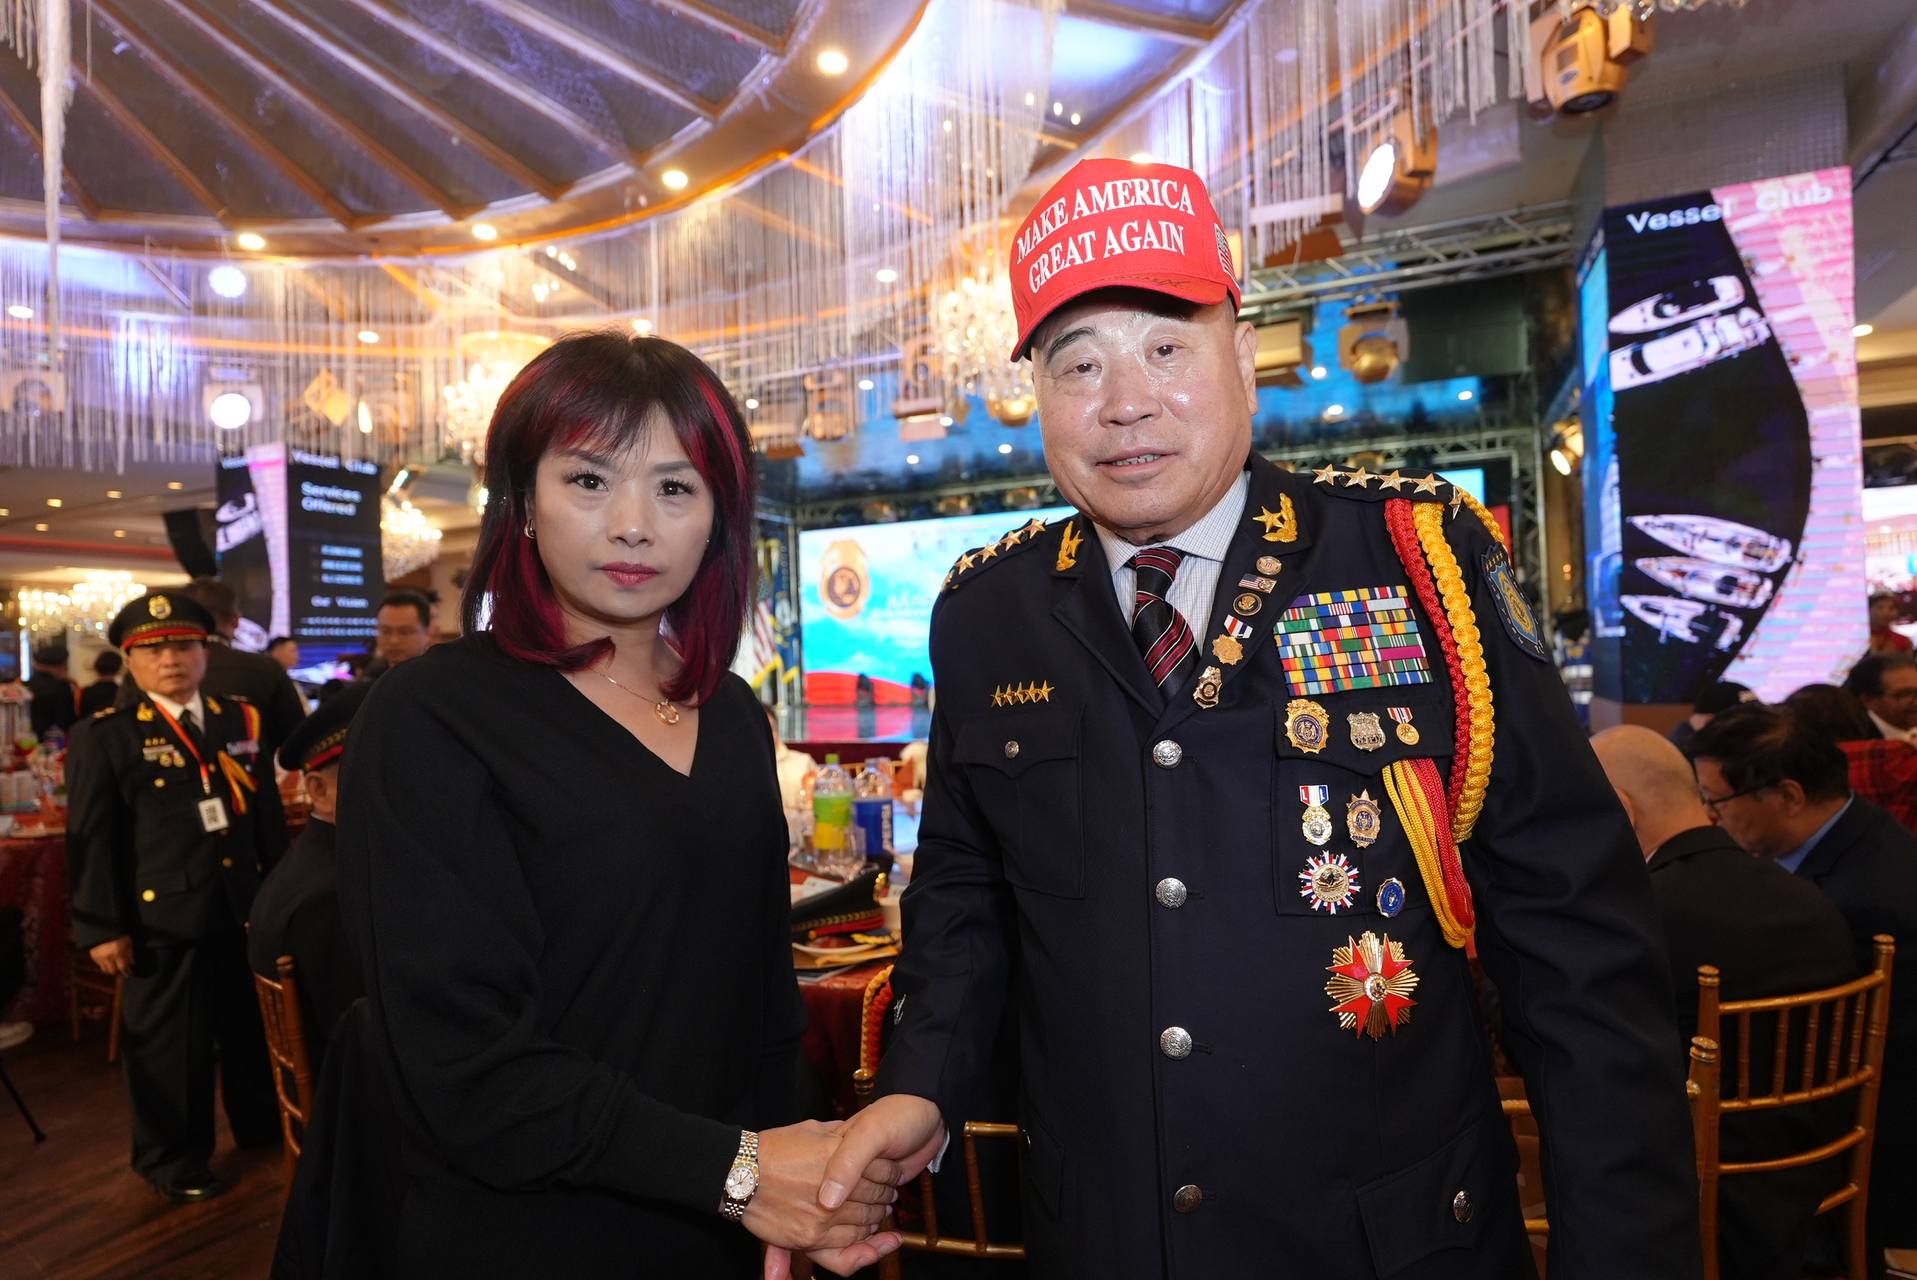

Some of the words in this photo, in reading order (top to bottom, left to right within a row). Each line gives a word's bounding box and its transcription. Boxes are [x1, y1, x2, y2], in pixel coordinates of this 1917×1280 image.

[1016, 197, 1069, 264] MAKE
[1072, 178, 1196, 221] AMERICA
[1626, 201, 1736, 234] Vessel
[1757, 185, 1834, 212] Club
[1028, 230, 1096, 294] GREAT
[1103, 220, 1185, 258] AGAIN
[300, 481, 363, 503] Services
[301, 496, 357, 516] Offered
